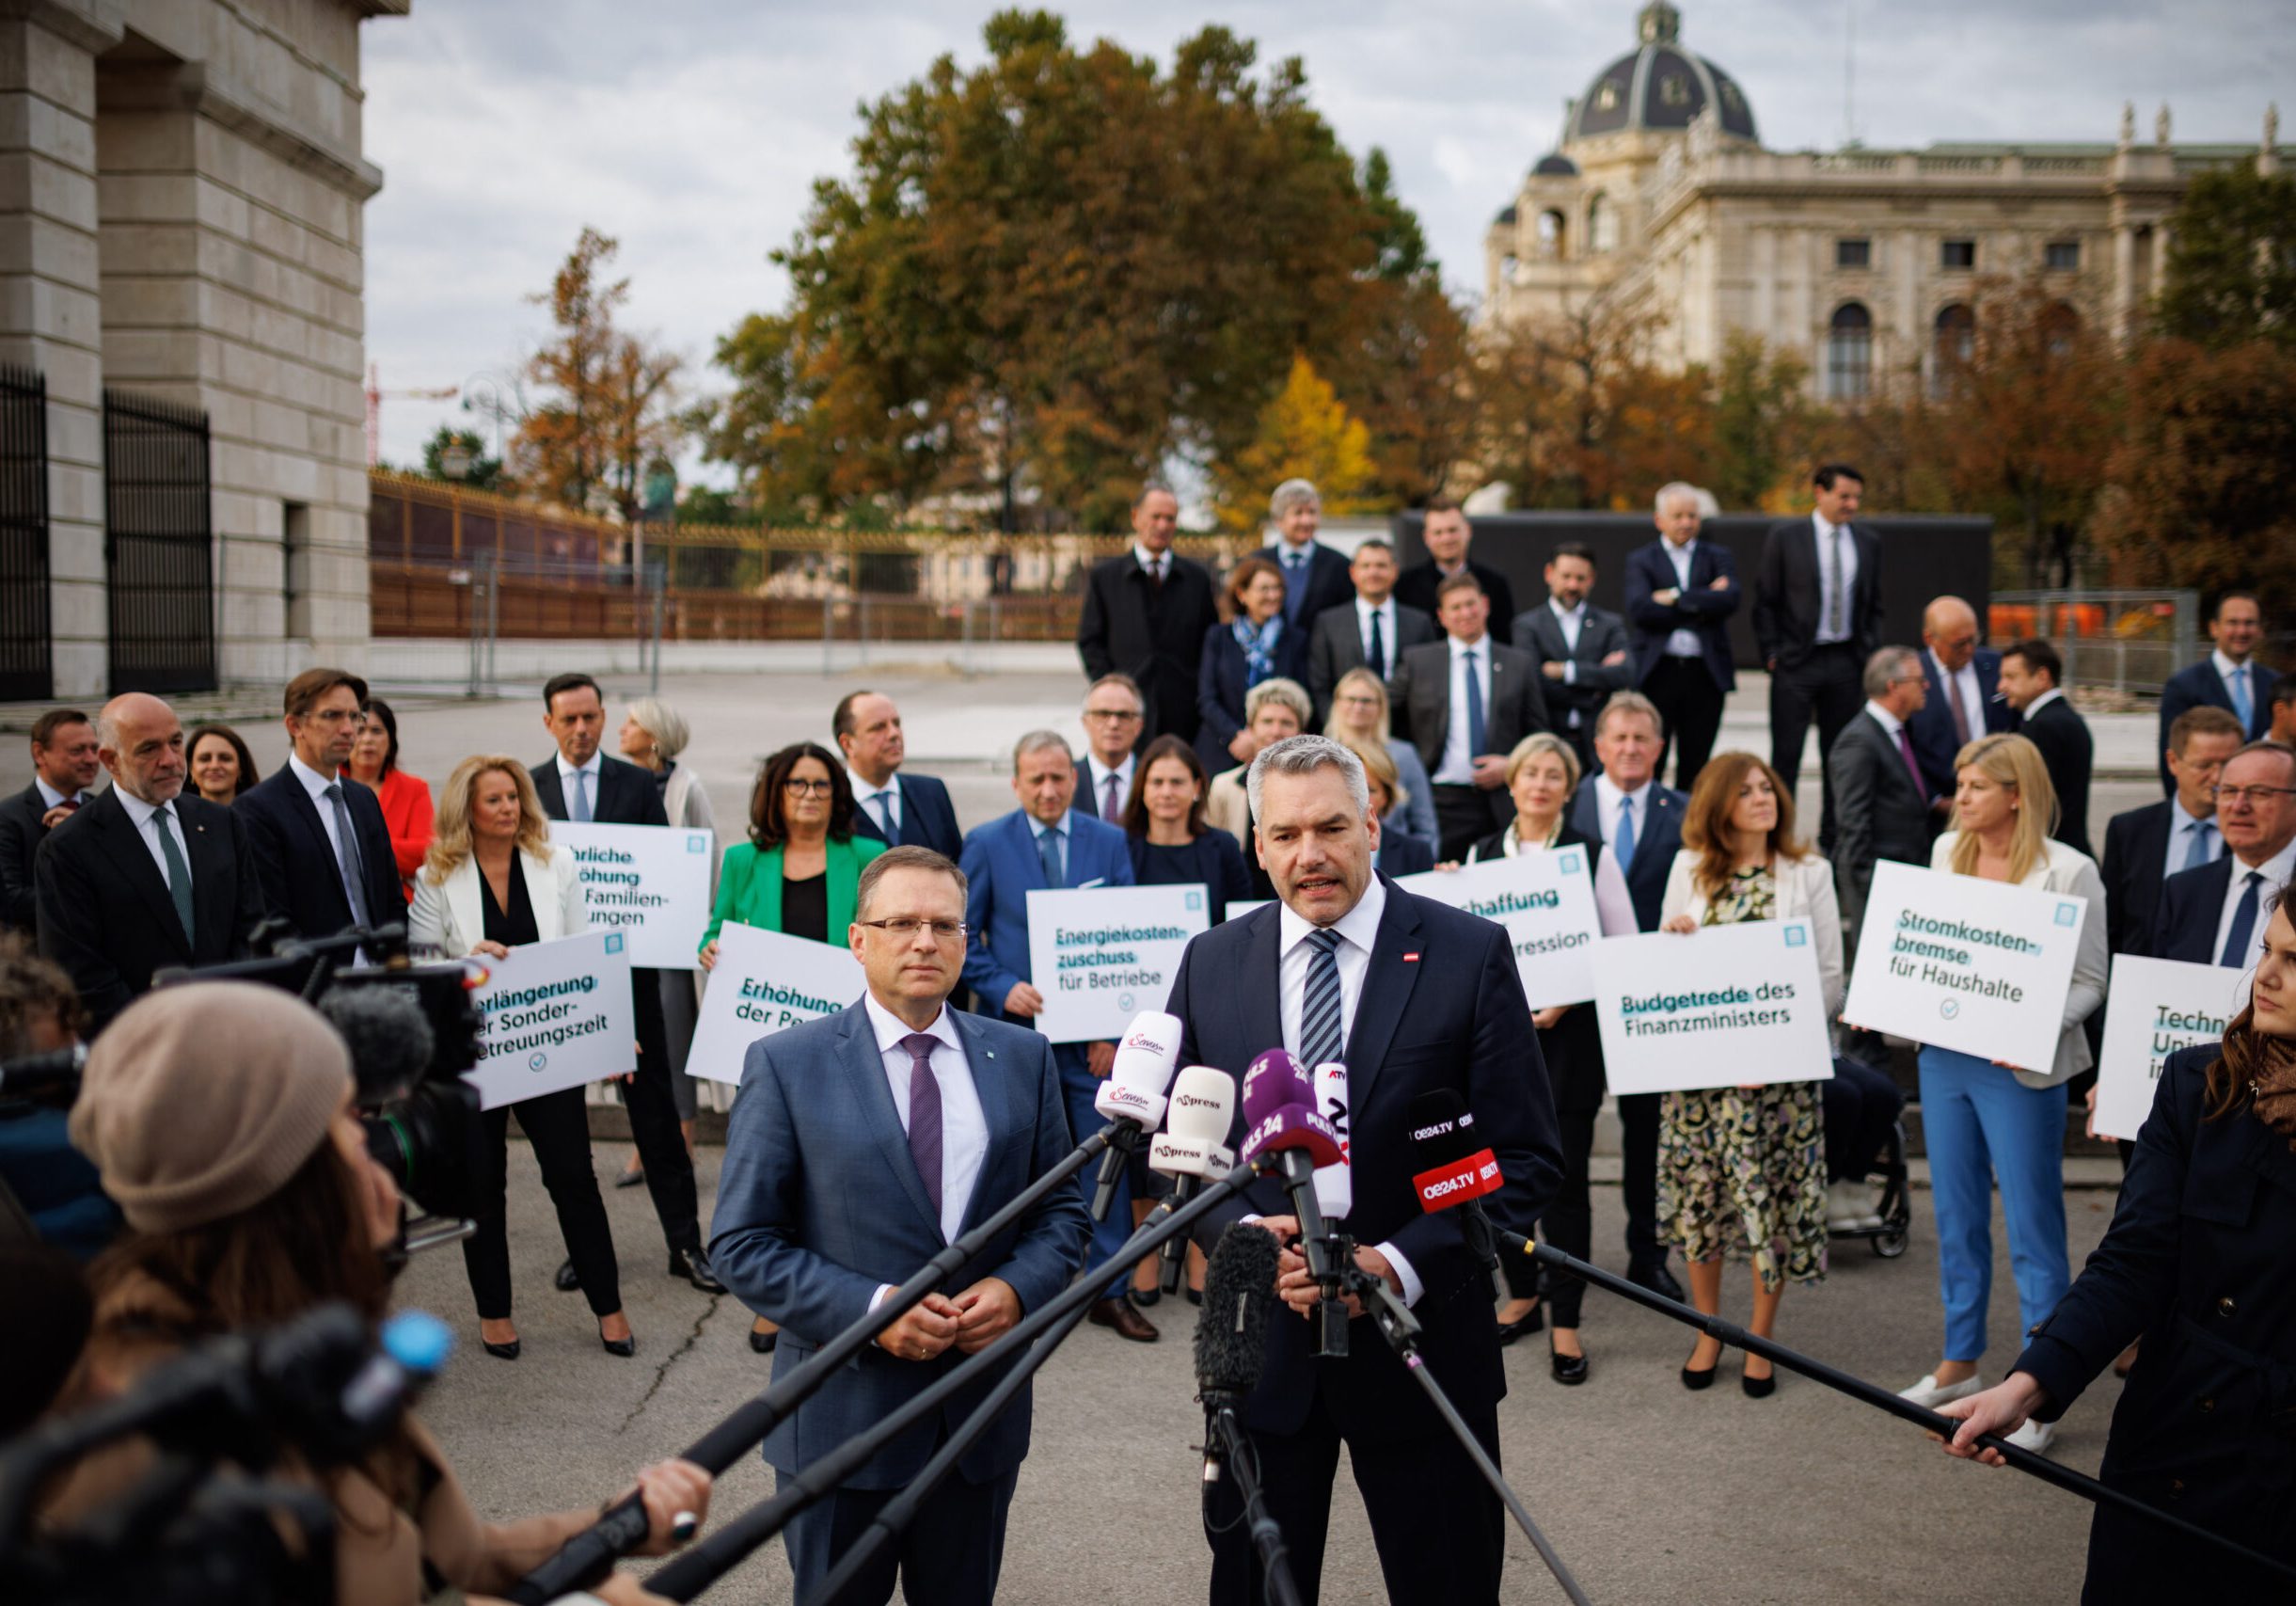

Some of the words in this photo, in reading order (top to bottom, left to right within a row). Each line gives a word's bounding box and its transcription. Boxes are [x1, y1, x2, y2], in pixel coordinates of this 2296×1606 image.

[579, 867, 640, 886] öhung
[585, 888, 670, 907] Familien-
[1461, 888, 1560, 916] haffung
[1055, 924, 1187, 946] Energiekosten-
[1900, 909, 2035, 952] Stromkosten-
[1058, 949, 1134, 968] zuschuss
[1512, 931, 1590, 959] ression
[1894, 932, 1969, 964] bremse
[1059, 972, 1082, 991] für
[1089, 969, 1162, 989] Betriebe
[1890, 955, 1916, 978] für
[1922, 962, 2023, 1003] Haushalte
[476, 975, 594, 1012] erlängerung
[1622, 984, 1749, 1015] Budgetrede
[1755, 981, 1795, 1002] des
[478, 1020, 495, 1037] er
[500, 1002, 578, 1031] Sonder-
[736, 1002, 772, 1025] der
[1624, 1008, 1791, 1037] Finanzministers
[2157, 1006, 2233, 1034] Techn
[477, 1014, 609, 1060] etreuungszeit
[1329, 1070, 1346, 1080] ATV
[1263, 1113, 1283, 1138] 24
